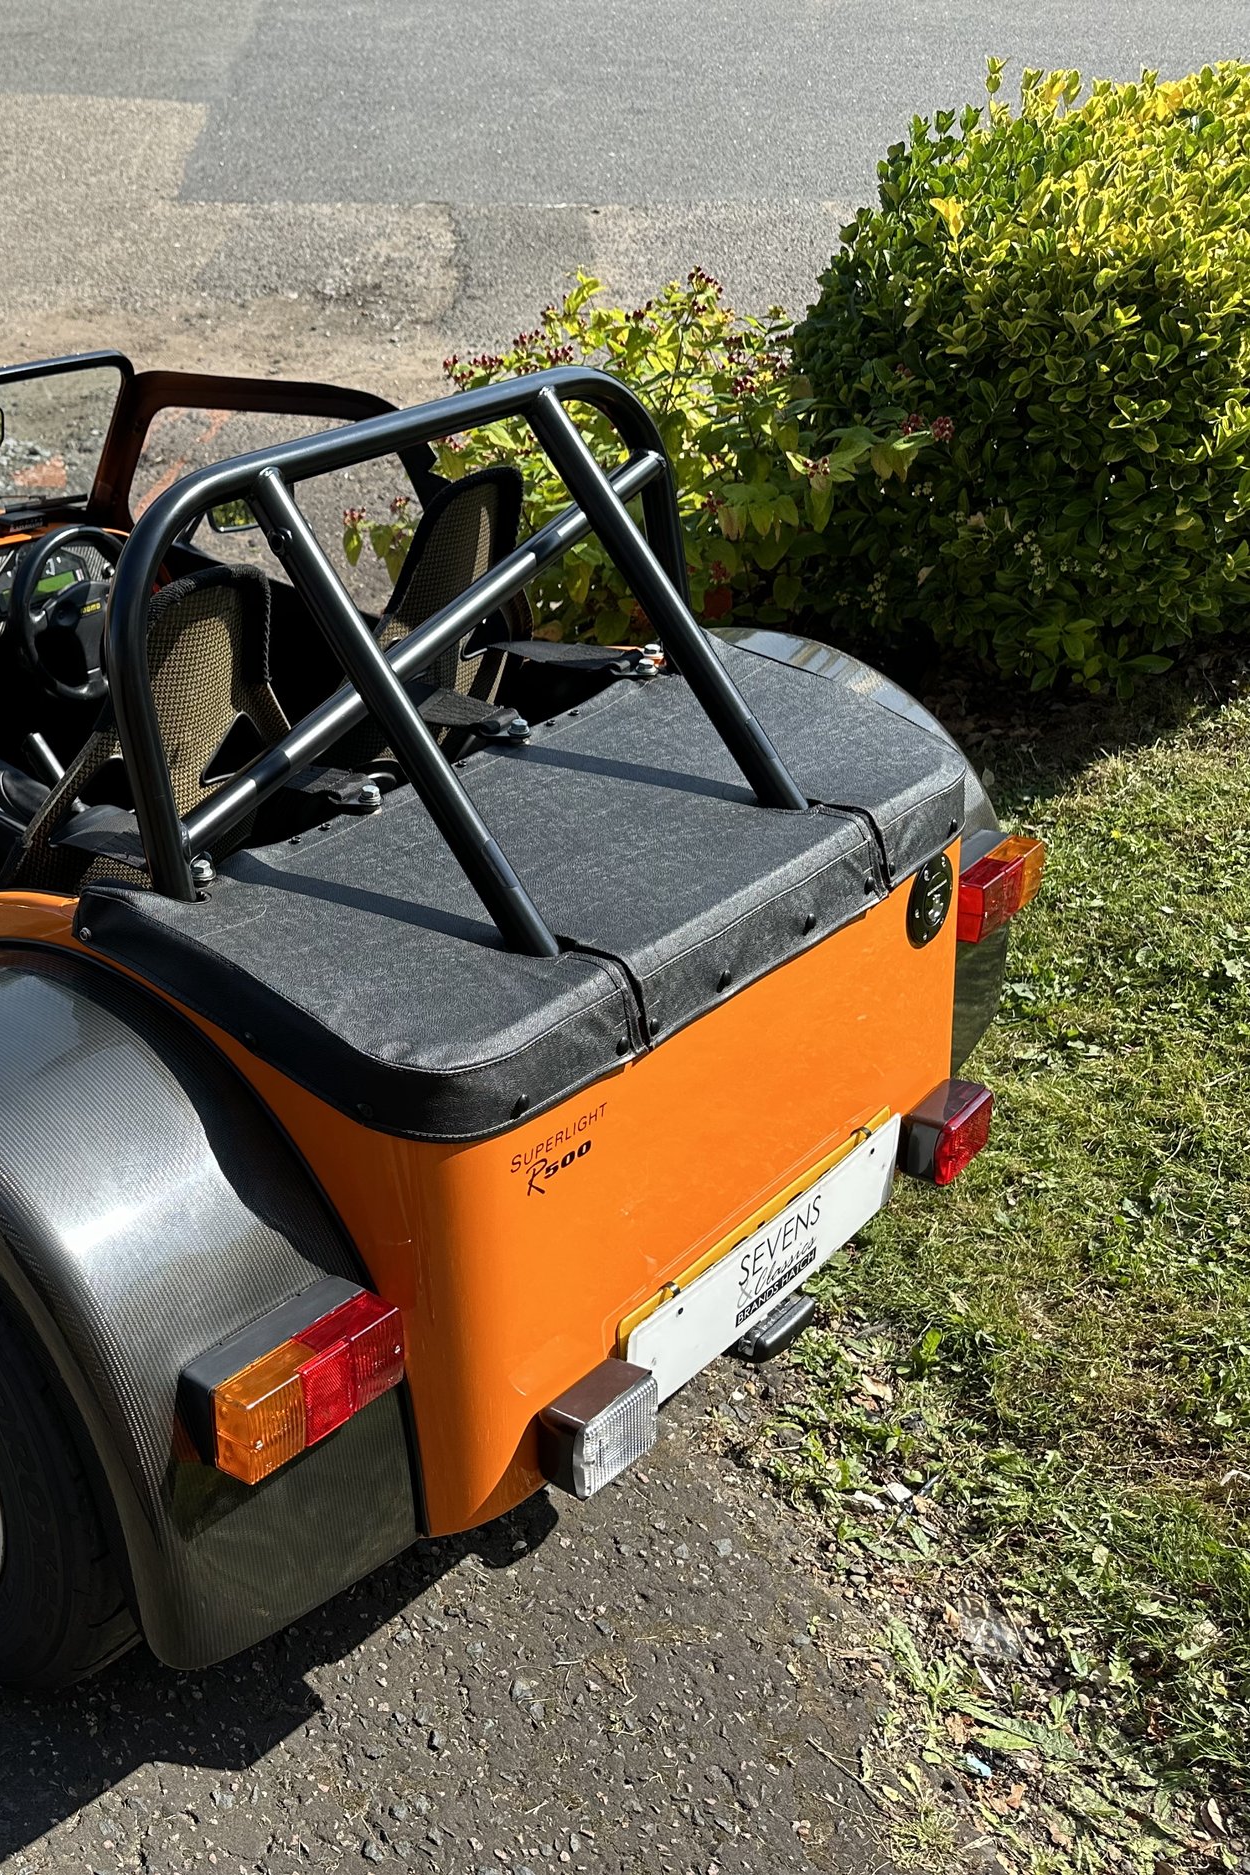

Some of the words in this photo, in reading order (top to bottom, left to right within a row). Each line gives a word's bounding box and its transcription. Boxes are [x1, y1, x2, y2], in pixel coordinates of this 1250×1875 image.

[510, 1102, 607, 1173] SUPERLIGHT
[526, 1139, 592, 1196] R500
[738, 1194, 822, 1286] SEVENS
[754, 1236, 818, 1296] Classics
[737, 1281, 780, 1325] BRANDS
[781, 1249, 816, 1286] HATCH
